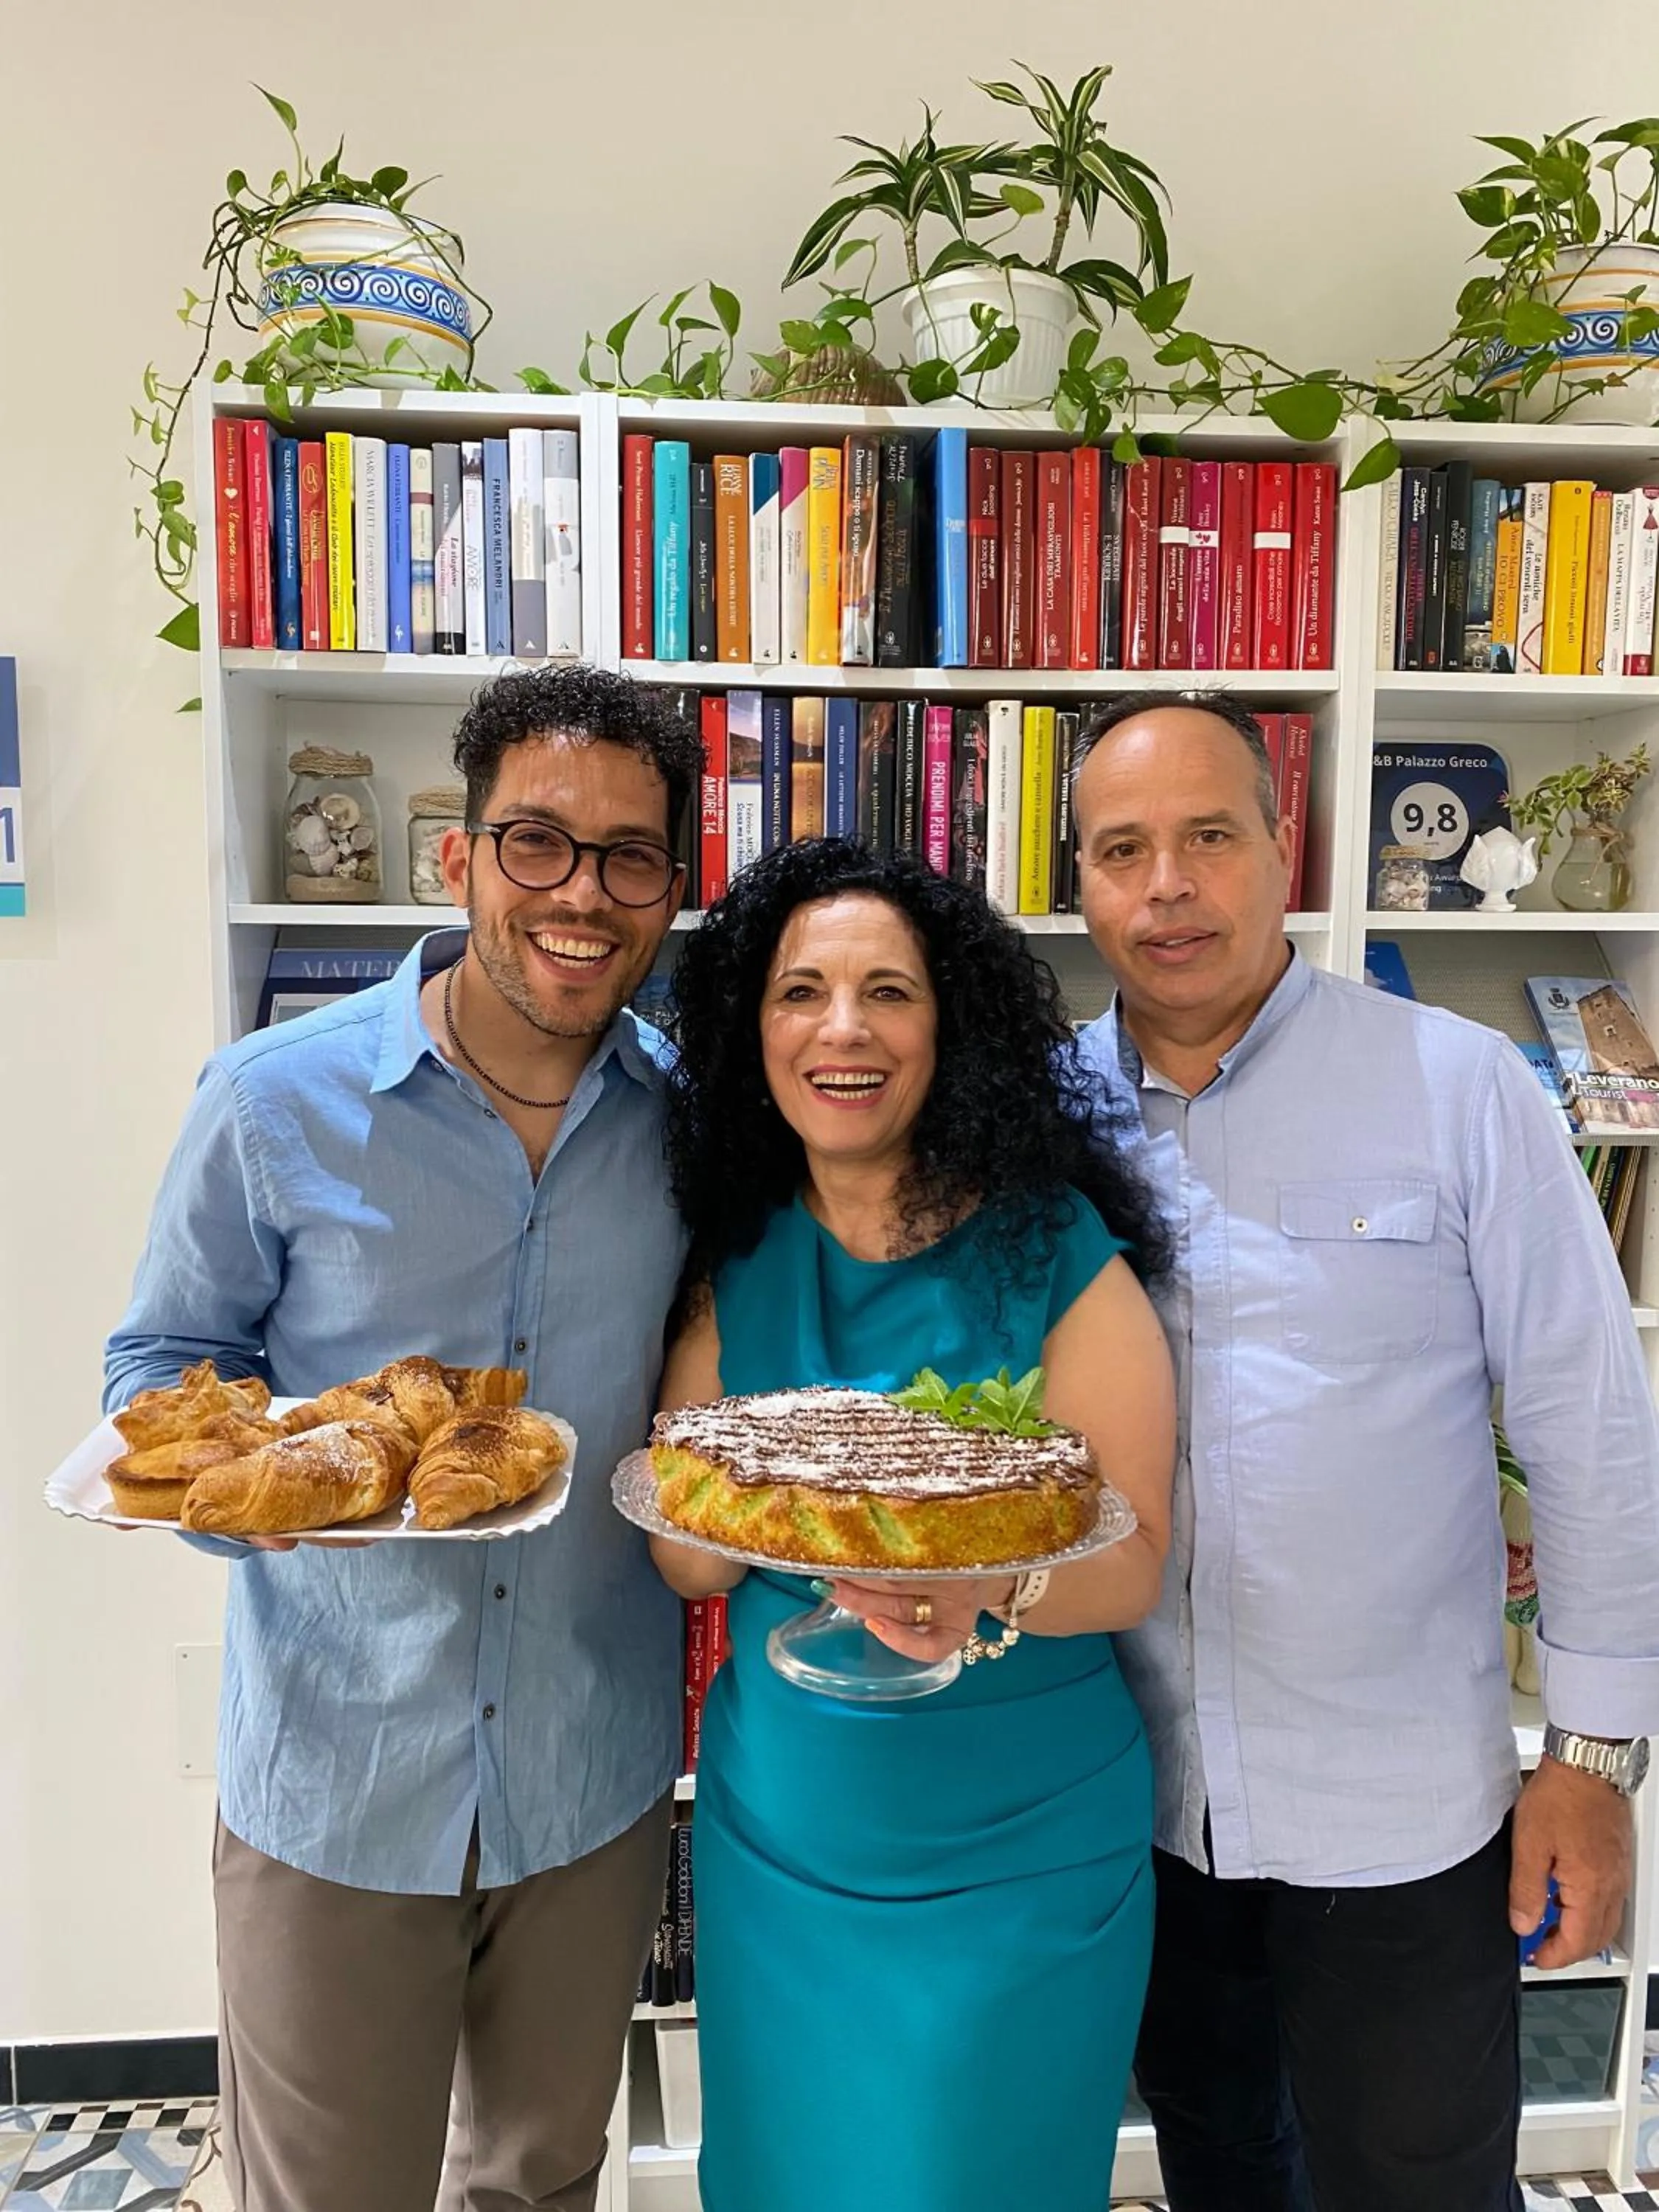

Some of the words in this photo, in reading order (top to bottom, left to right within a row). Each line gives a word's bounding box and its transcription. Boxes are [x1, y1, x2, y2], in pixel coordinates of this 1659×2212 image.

[284, 450, 292, 472] ELENA
[854, 449, 865, 484] Domani
[720, 465, 732, 496] RICE
[493, 479, 502, 535] FRANCESCA
[851, 487, 861, 516] scappo
[451, 537, 459, 548] La
[667, 522, 678, 555] Tiffany
[1310, 530, 1321, 563] Tiffany
[1510, 527, 1519, 553] Anna
[1526, 540, 1534, 554] del
[1617, 543, 1625, 554] LA
[450, 551, 459, 587] stagione
[493, 538, 503, 588] MELANDRI
[1310, 566, 1319, 577] da
[1499, 555, 1508, 569] IO
[1533, 553, 1543, 563] Le
[1615, 557, 1624, 585] MAPPA
[1498, 573, 1507, 585] CI
[1531, 566, 1542, 601] amiche
[1046, 599, 1054, 610] LA
[1139, 598, 1148, 621] parole
[1308, 579, 1318, 619] diamante
[1496, 590, 1506, 627] PROVO
[1522, 595, 1531, 614] sera
[1613, 587, 1623, 613] DELLA
[1232, 596, 1242, 633] Paradiso
[1613, 613, 1621, 632] VITA
[1308, 622, 1318, 636] Un
[905, 715, 915, 759] FEDERICO
[1288, 725, 1298, 759] Hosseini
[1298, 728, 1307, 756] Khaled
[967, 763, 975, 783] dolci
[1397, 756, 1446, 767] Palazzo
[1450, 757, 1487, 768] Greco
[773, 772, 781, 782] IN
[905, 762, 914, 797] MOCCIA
[930, 762, 946, 813] PRENDIMI
[1033, 771, 1042, 807] cannella
[703, 776, 716, 817] AMORE
[904, 803, 913, 815] HO
[966, 785, 975, 832] ingredienti
[1290, 780, 1300, 821] cacciatore
[703, 821, 716, 834] 14
[736, 803, 745, 824] Scusa
[745, 803, 754, 835] Federico
[930, 816, 945, 837] PER
[1403, 803, 1458, 837] 9,8
[737, 827, 743, 837] ma
[1031, 815, 1040, 850] zucchero
[966, 849, 975, 881] destino
[1576, 1071, 1659, 1090] Leverano
[1584, 1088, 1628, 1099] Tourist
[678, 1829, 692, 1855] Luca
[678, 1857, 692, 1904] Goldoni
[678, 1911, 692, 1957] DIPENDE
